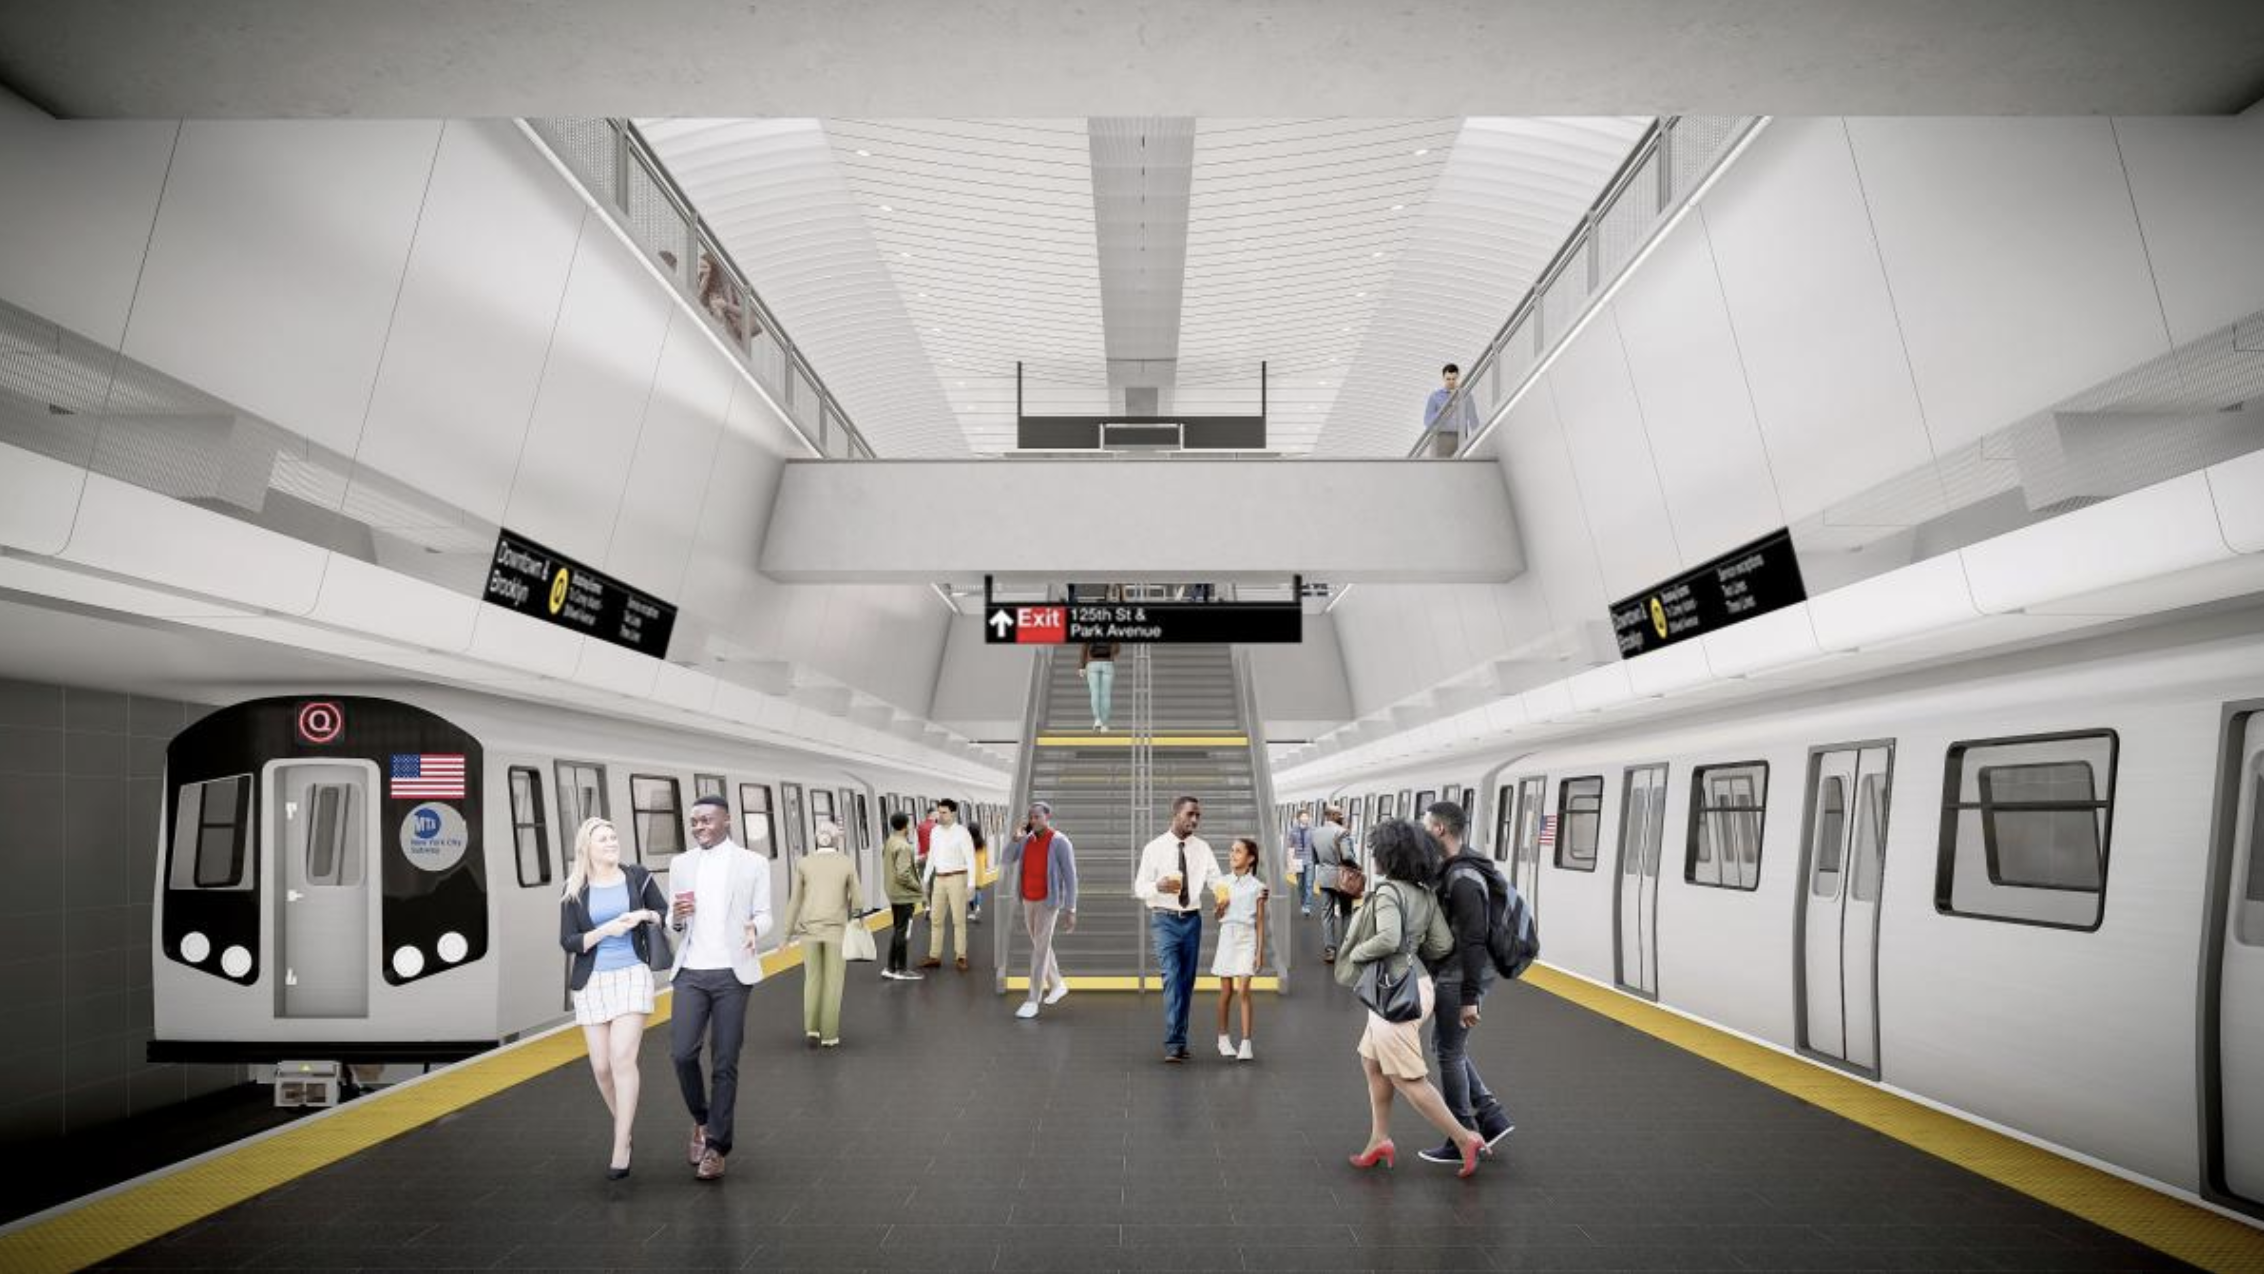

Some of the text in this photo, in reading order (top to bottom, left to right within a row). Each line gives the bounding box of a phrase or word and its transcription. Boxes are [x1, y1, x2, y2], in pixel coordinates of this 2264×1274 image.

[498, 541, 542, 578] Downtown
[490, 569, 528, 607] Brooklyn
[1016, 606, 1060, 628] Exit
[1070, 607, 1146, 621] 125th St &
[1070, 623, 1162, 638] Park Avenue
[308, 710, 332, 733] Q
